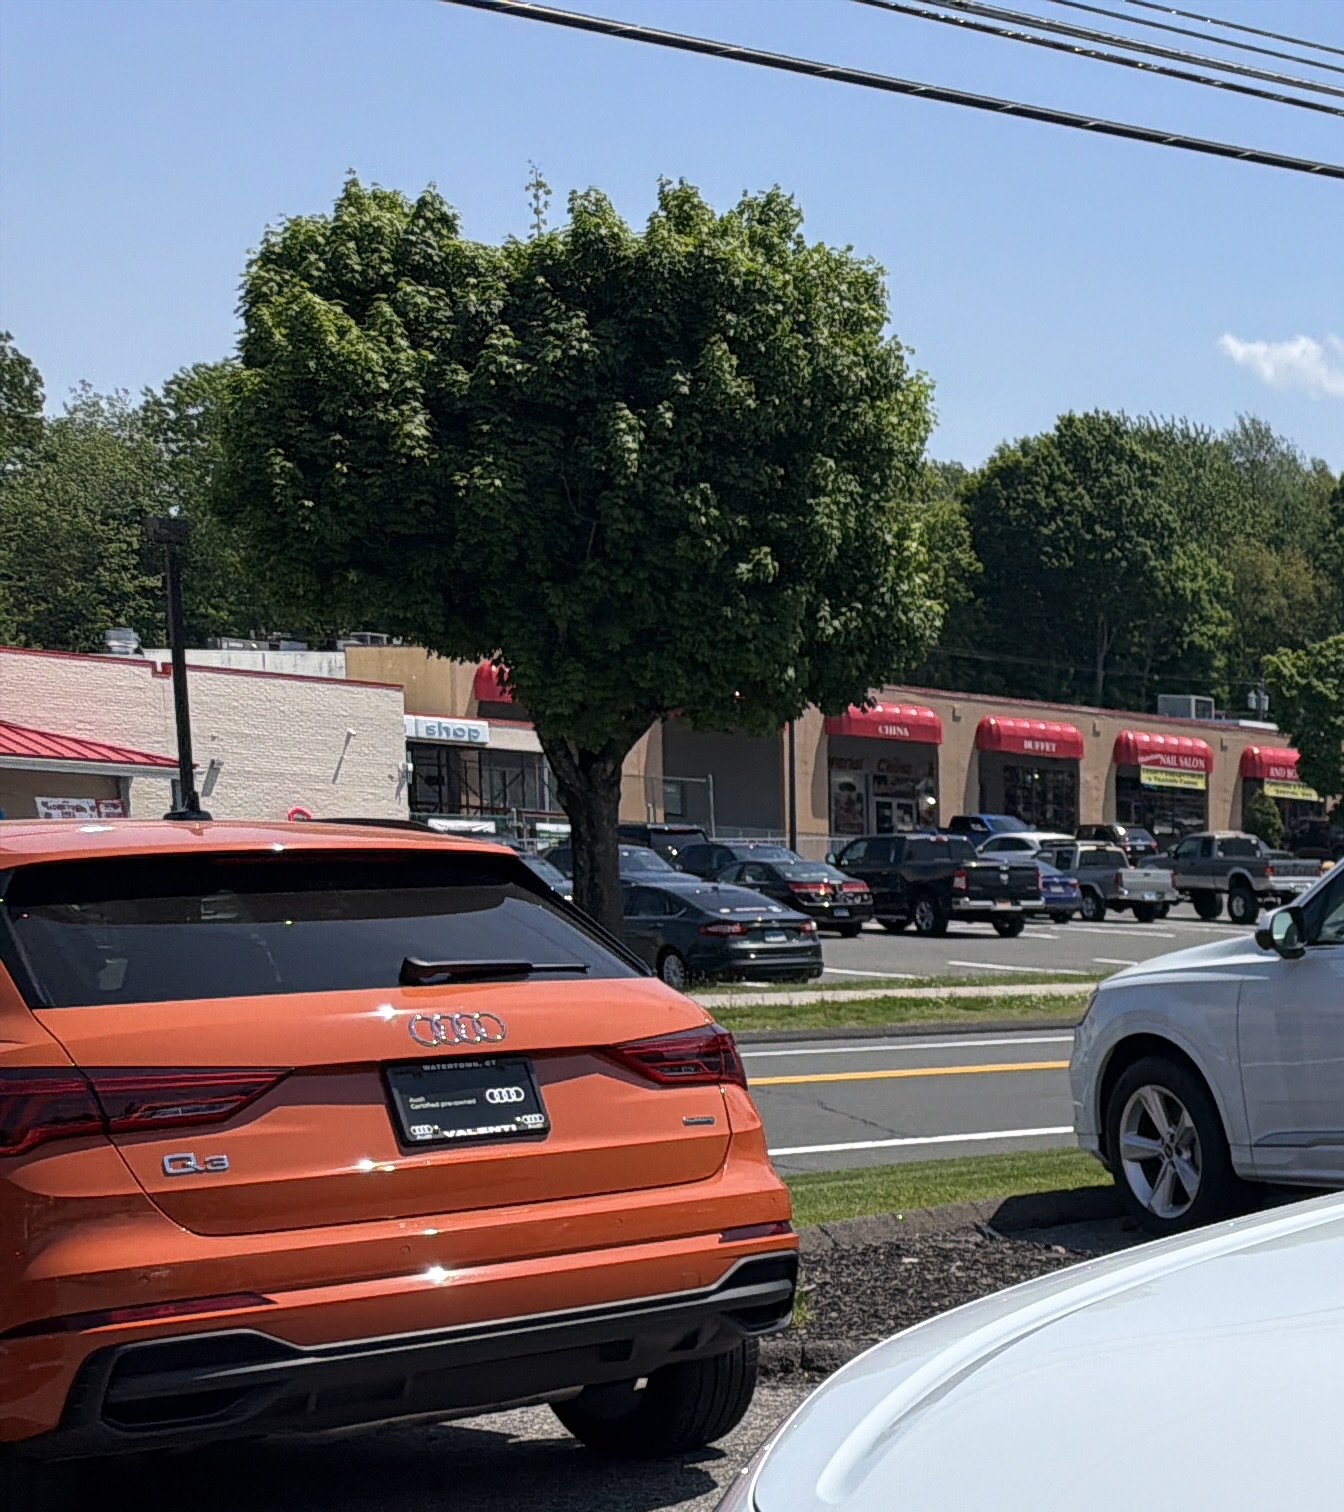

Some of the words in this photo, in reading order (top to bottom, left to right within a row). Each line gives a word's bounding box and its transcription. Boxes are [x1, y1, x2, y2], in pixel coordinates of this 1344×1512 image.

[425, 721, 480, 740] shop
[878, 725, 909, 737] CHINA
[1023, 739, 1056, 752] BUFFET
[1160, 754, 1178, 767] NAIL
[1179, 757, 1205, 769] SALON
[422, 1062, 483, 1071] WATERTOWN,
[443, 1124, 517, 1138] VALENTI
[163, 1152, 229, 1176] Q3
